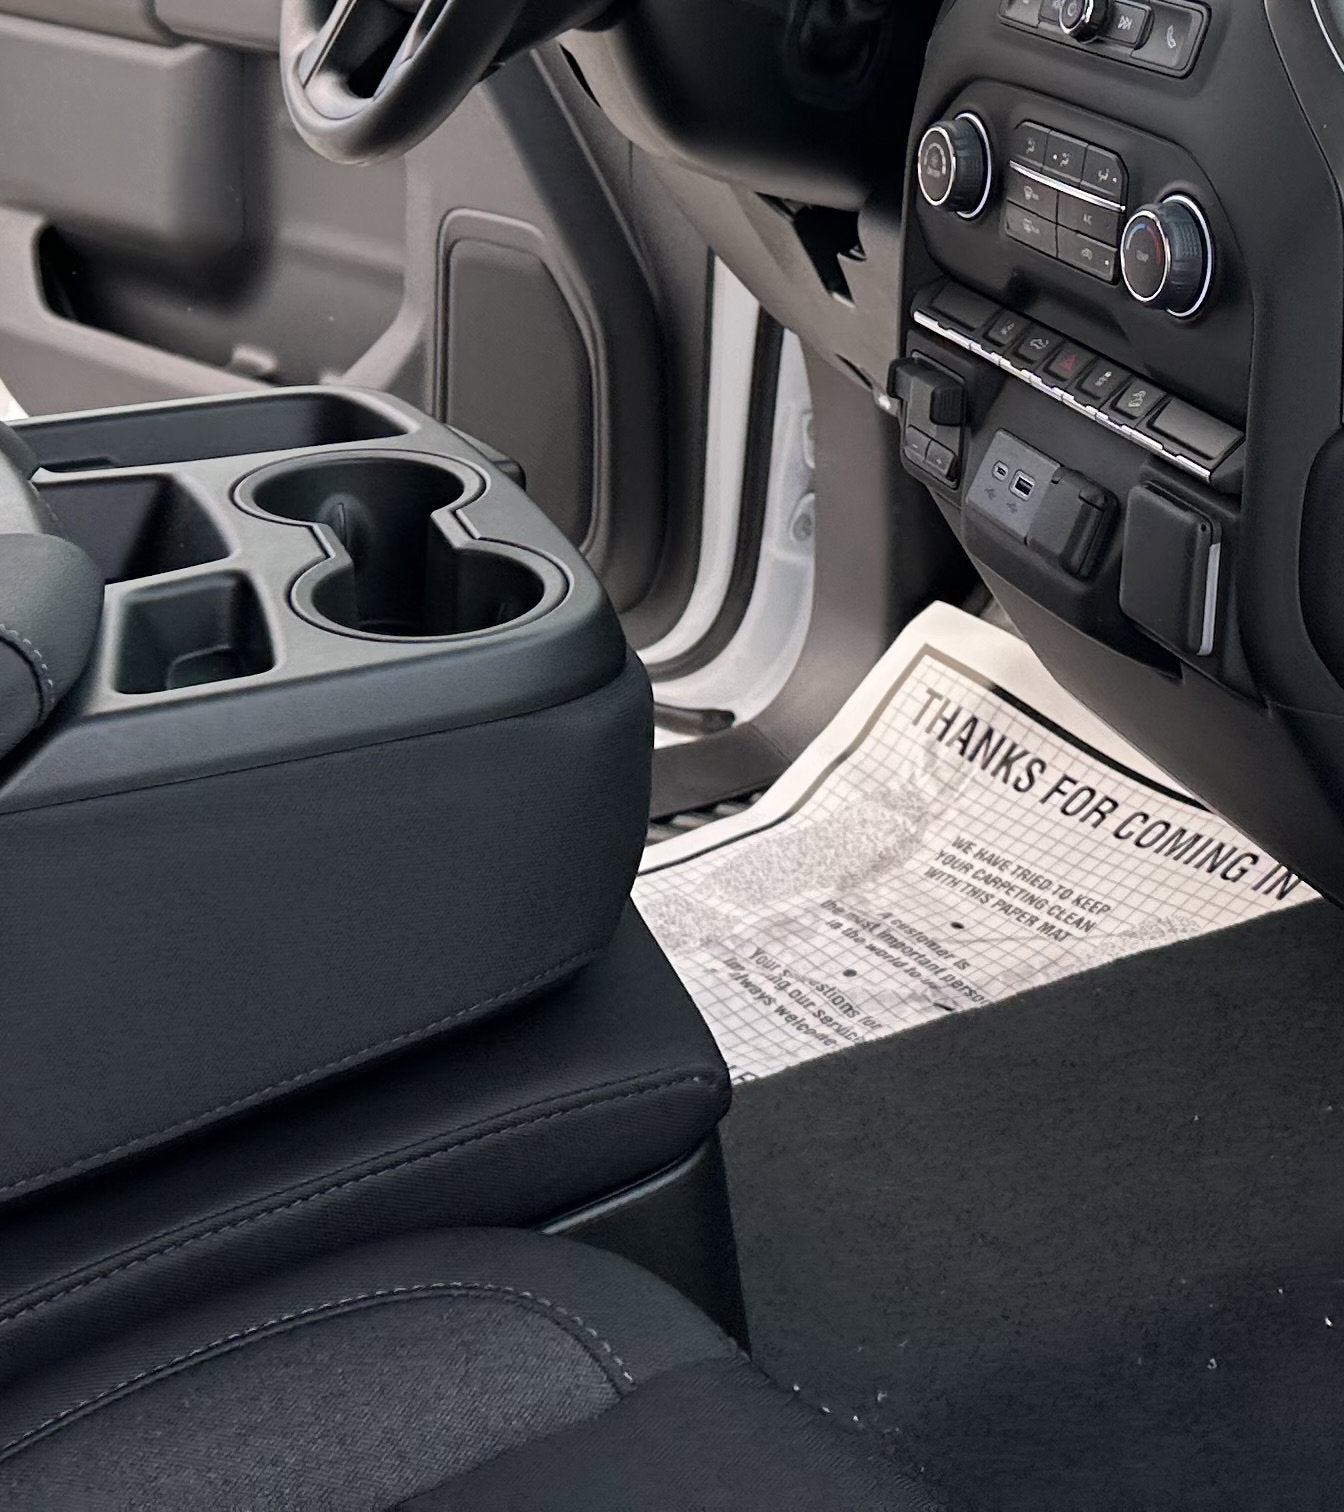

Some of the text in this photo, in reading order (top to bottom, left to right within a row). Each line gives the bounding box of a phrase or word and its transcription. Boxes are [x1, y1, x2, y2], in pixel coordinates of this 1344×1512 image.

[912, 687, 1303, 901] THANKS FOR COMING IN
[924, 866, 1075, 943] WITH THIS PAPER MAT
[934, 849, 1097, 933] YOUR CARPETING CLEAN
[952, 836, 1111, 915] WE HAVE TRIED TO KEEP
[820, 900, 845, 915] the
[878, 928, 947, 975] important
[842, 928, 866, 944] the
[865, 943, 908, 968] world
[905, 967, 922, 979] to
[749, 947, 782, 971] Your
[858, 1015, 883, 1031] for
[788, 989, 816, 1011] our
